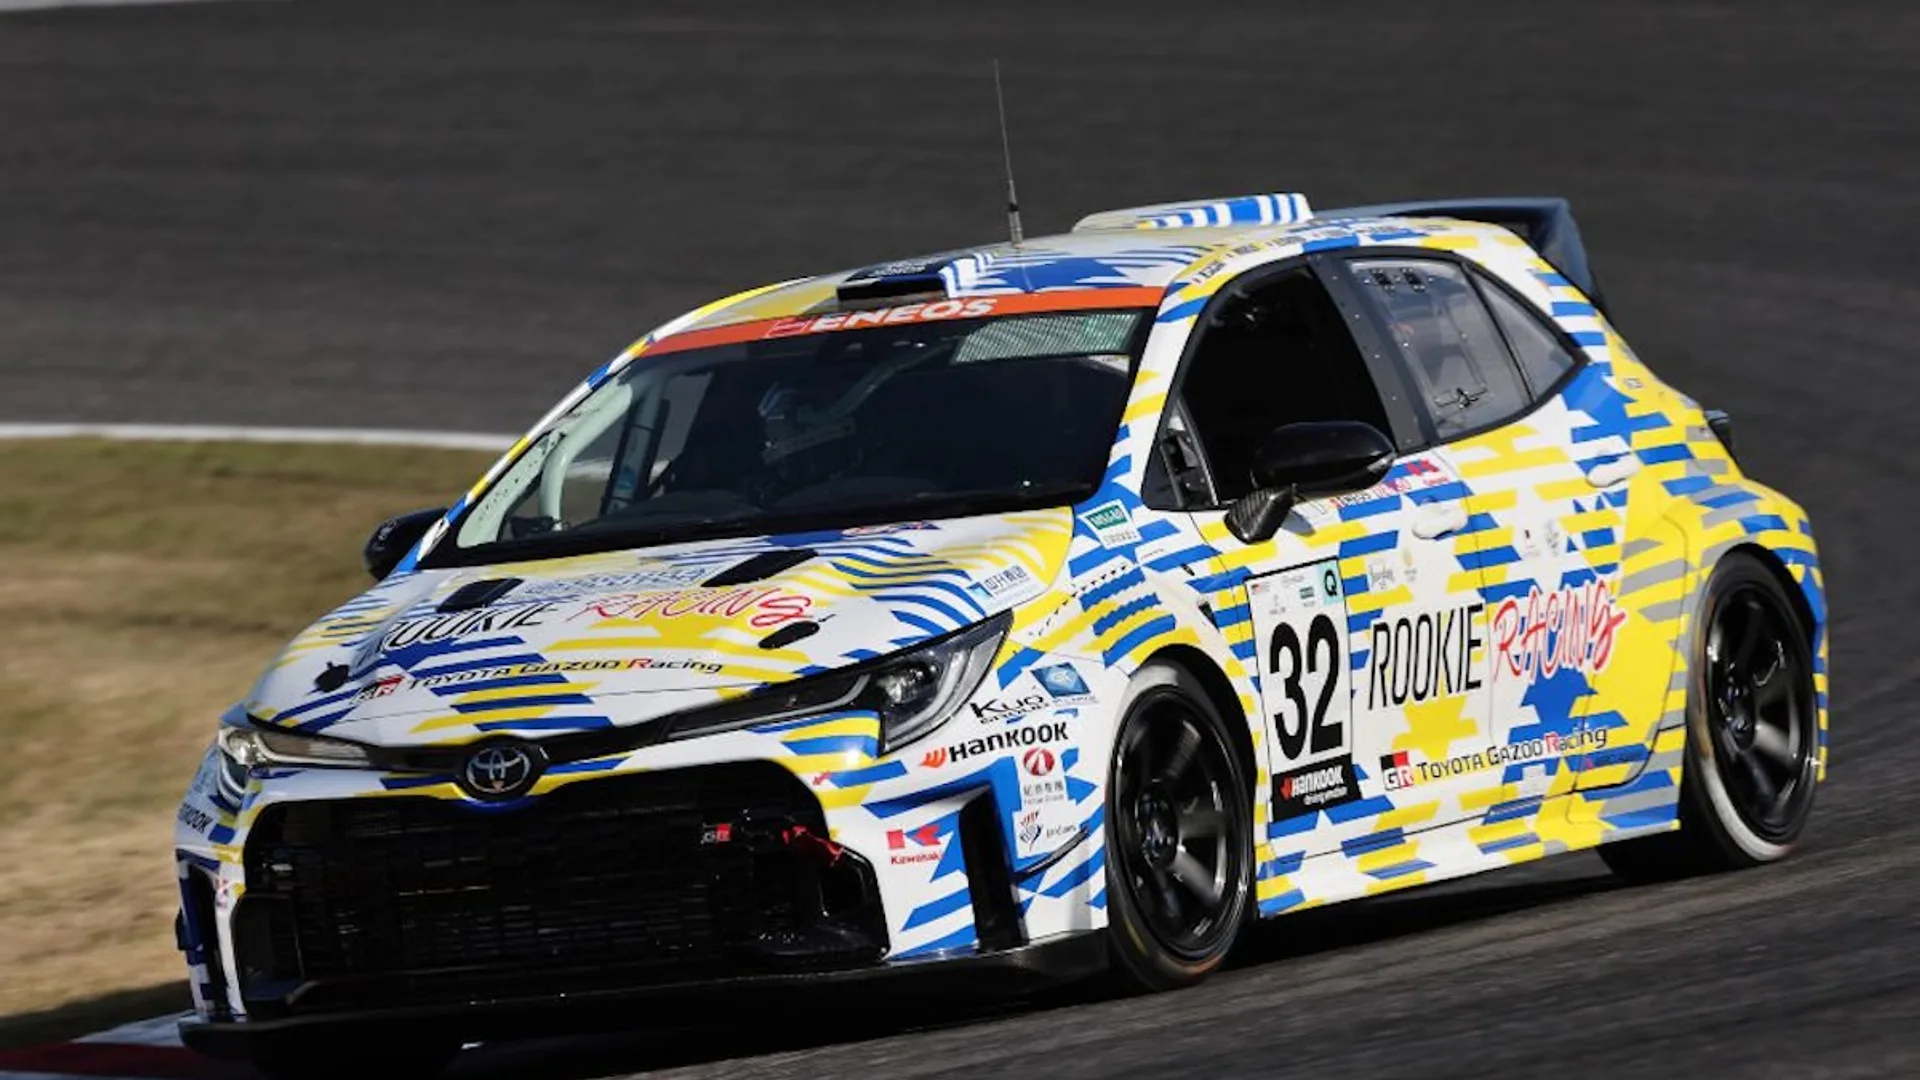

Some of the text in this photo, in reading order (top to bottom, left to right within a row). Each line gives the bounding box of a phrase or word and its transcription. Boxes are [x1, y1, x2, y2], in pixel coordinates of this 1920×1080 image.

[810, 298, 998, 332] ENEOS
[1323, 569, 1338, 597] Q
[1368, 578, 1627, 711] ROOKIE RACING
[409, 667, 512, 690] TOYOTA
[629, 656, 723, 675] Racing
[1268, 614, 1344, 761] 32
[1382, 727, 1609, 790] GR TOYOTA GAZOO Racing
